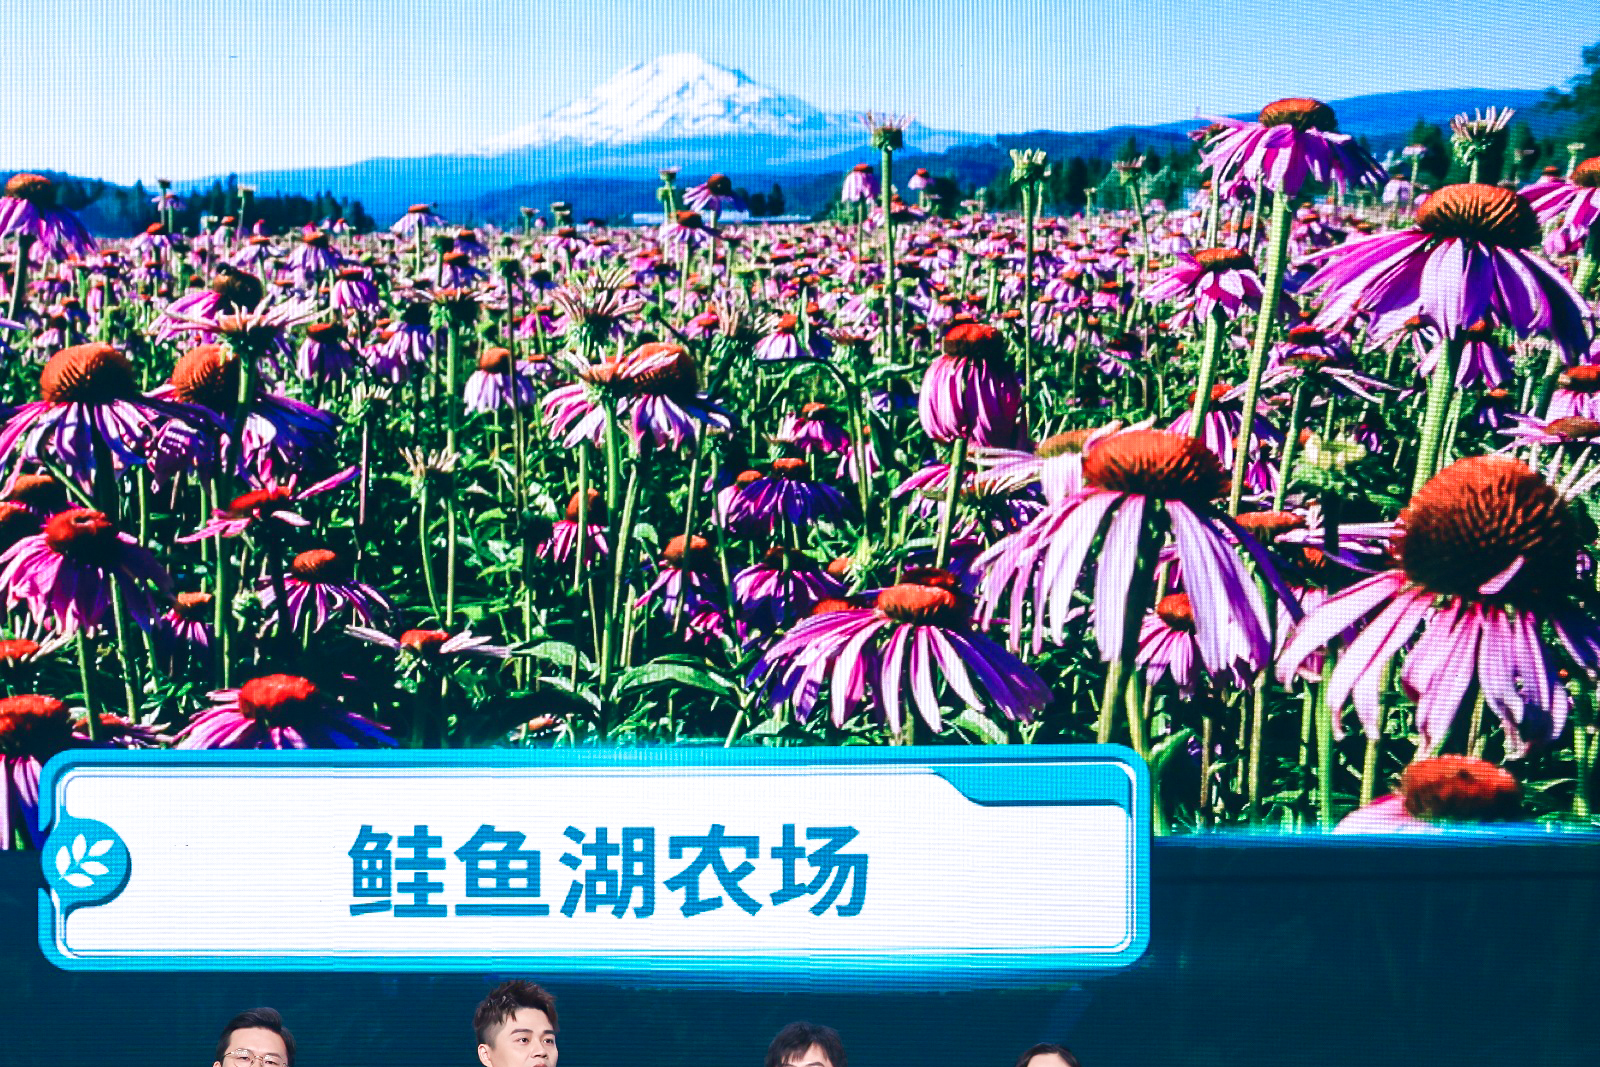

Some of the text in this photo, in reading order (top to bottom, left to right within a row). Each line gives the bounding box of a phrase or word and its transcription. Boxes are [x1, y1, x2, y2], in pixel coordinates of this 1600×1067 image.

[347, 823, 869, 919] 鲑鱼湖农场
